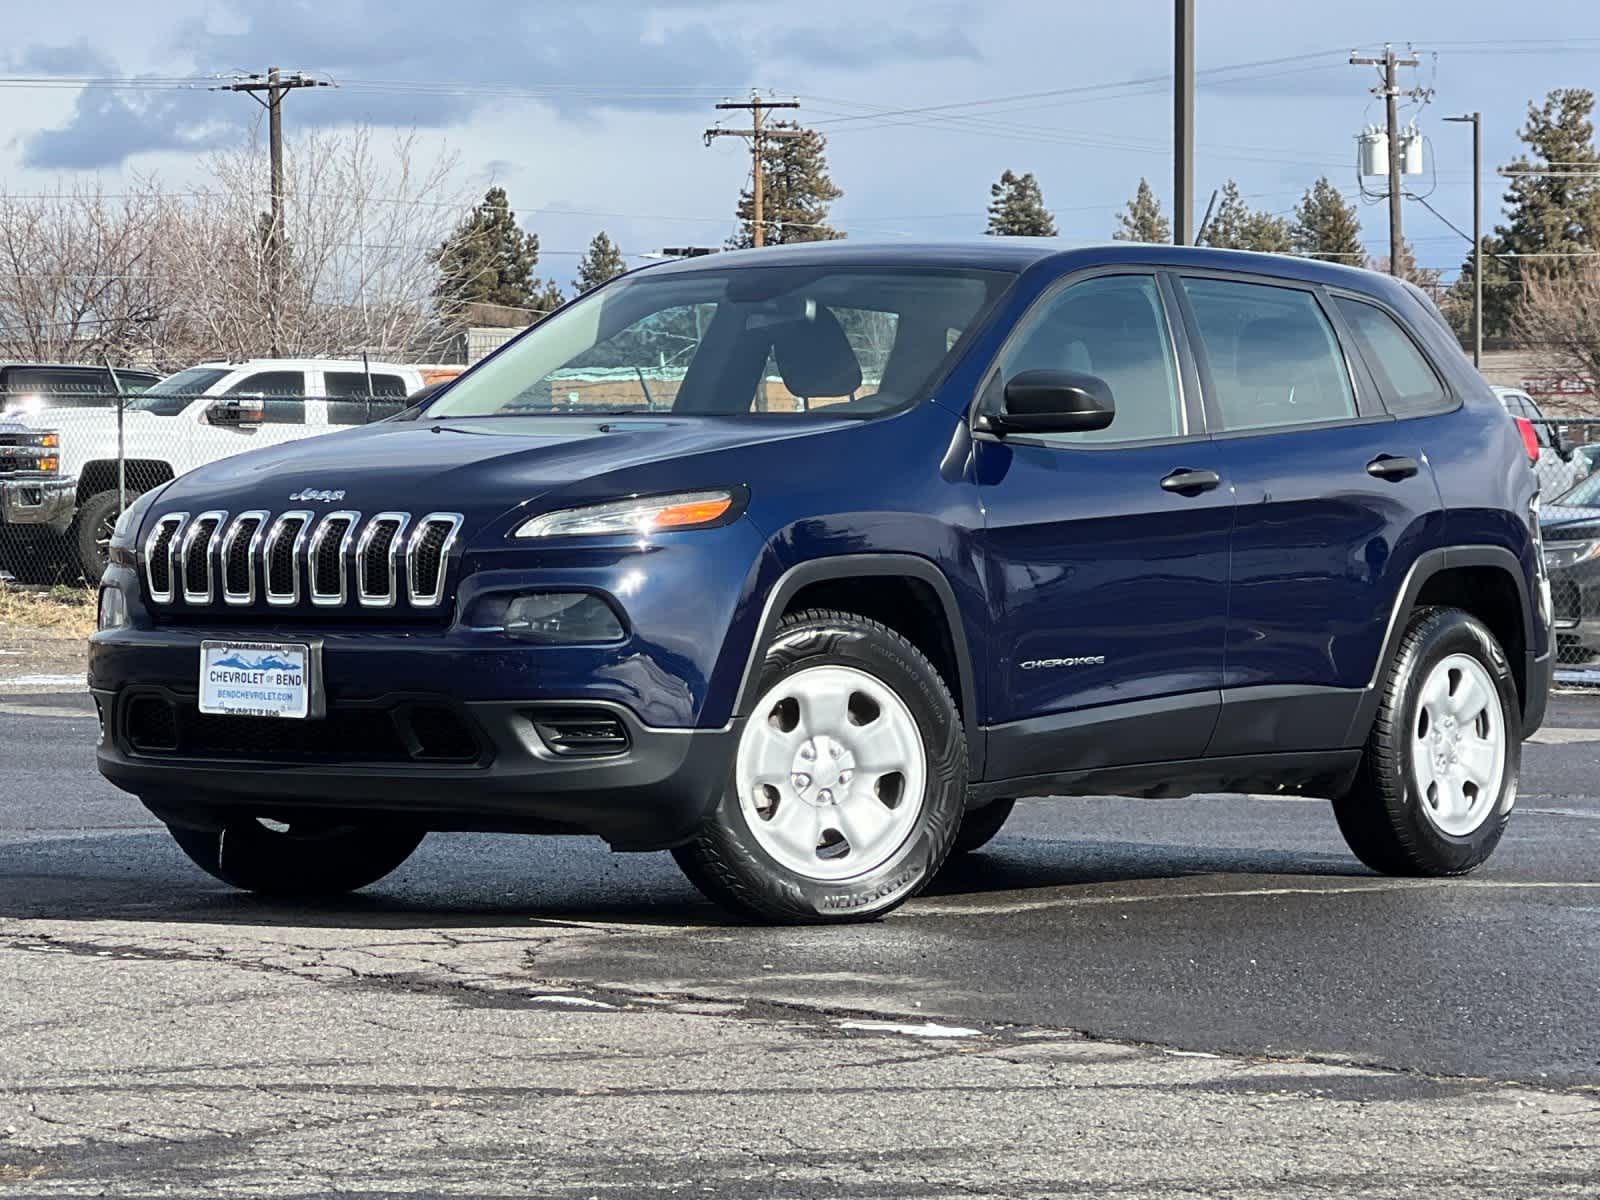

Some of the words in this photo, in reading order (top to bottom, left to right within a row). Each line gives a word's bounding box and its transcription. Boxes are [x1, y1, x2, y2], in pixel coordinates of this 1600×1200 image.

[289, 488, 346, 503] Jeep
[1018, 655, 1105, 670] CHEROKEE
[210, 671, 265, 684] CHEVROLET
[276, 674, 302, 686] BEND
[217, 689, 293, 701] BENDCHEVROLET.COM
